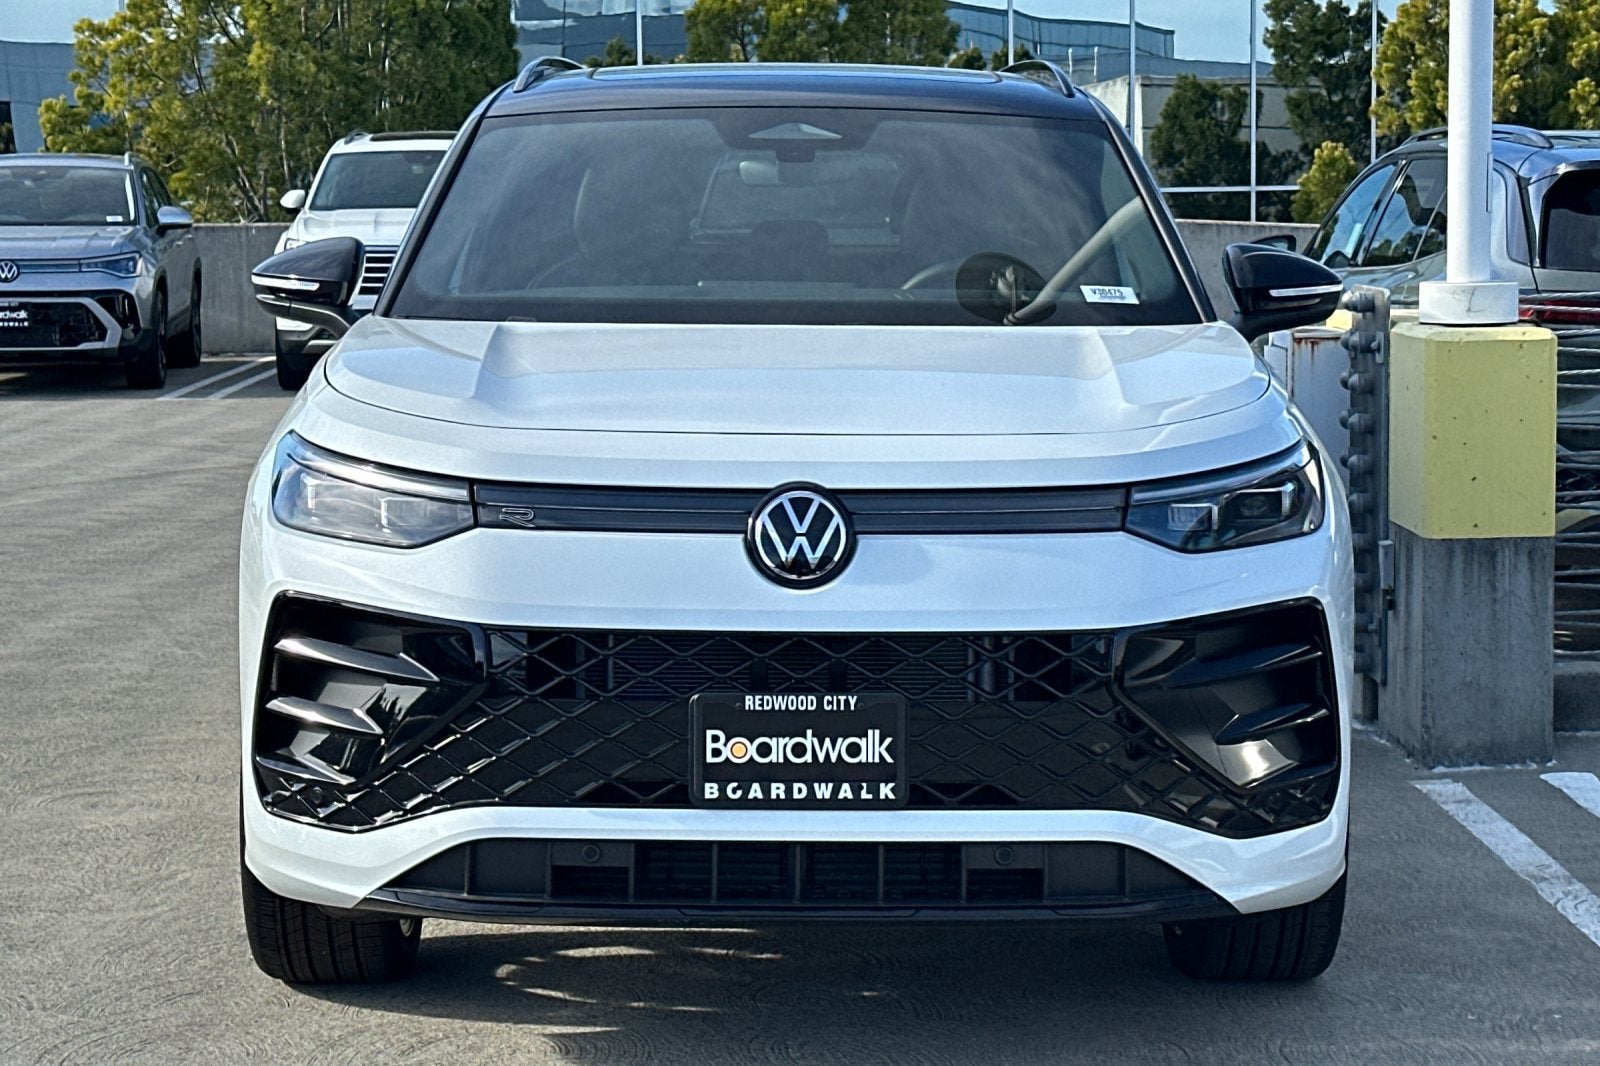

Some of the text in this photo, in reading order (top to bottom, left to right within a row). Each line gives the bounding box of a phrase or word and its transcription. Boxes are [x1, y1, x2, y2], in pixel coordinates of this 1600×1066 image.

[759, 493, 845, 576] VW
[745, 695, 858, 711] REDWOOD CITY
[705, 729, 894, 764] Boardwalk
[704, 782, 896, 800] BOARDWALK
